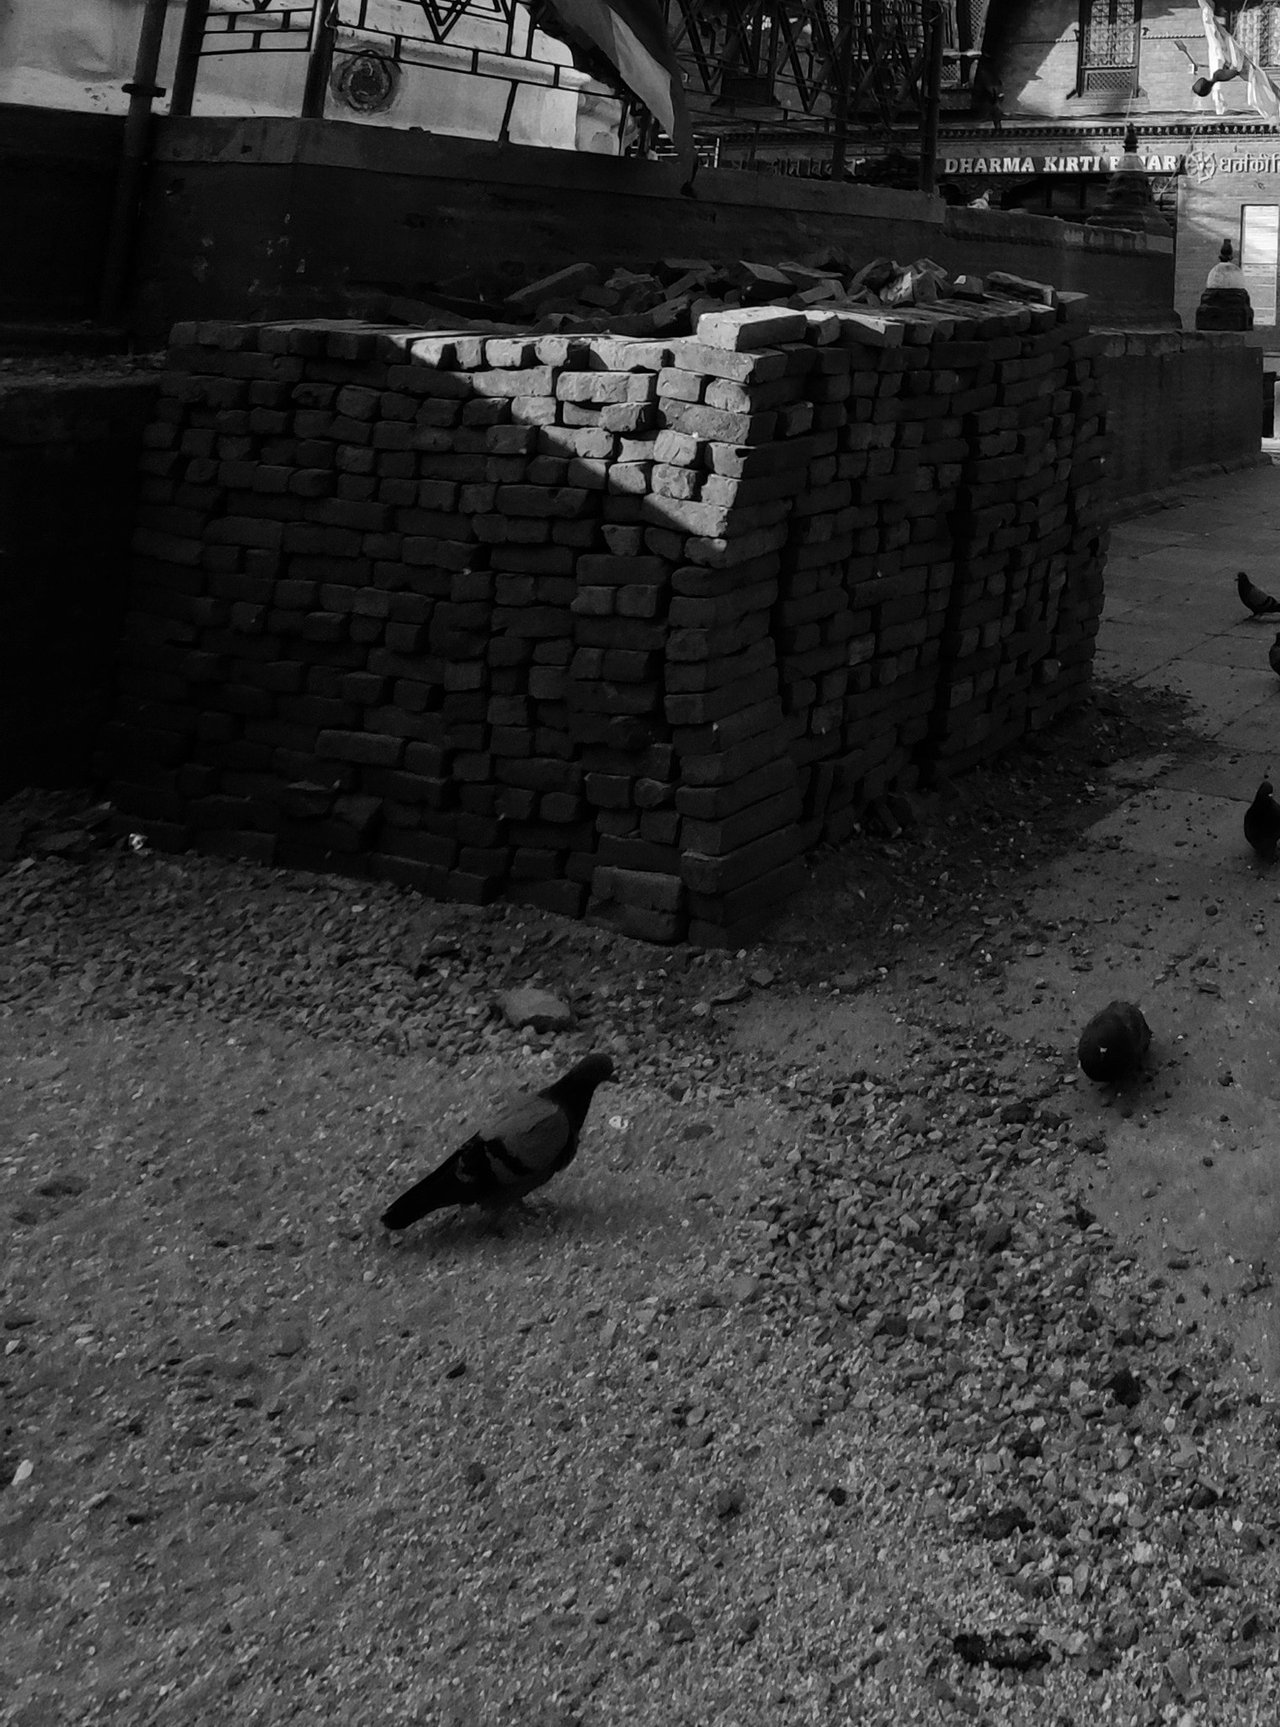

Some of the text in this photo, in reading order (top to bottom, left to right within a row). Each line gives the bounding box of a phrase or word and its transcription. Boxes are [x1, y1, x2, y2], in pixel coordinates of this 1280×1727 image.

[944, 154, 1177, 174] DHARMA KIRTI BAR
